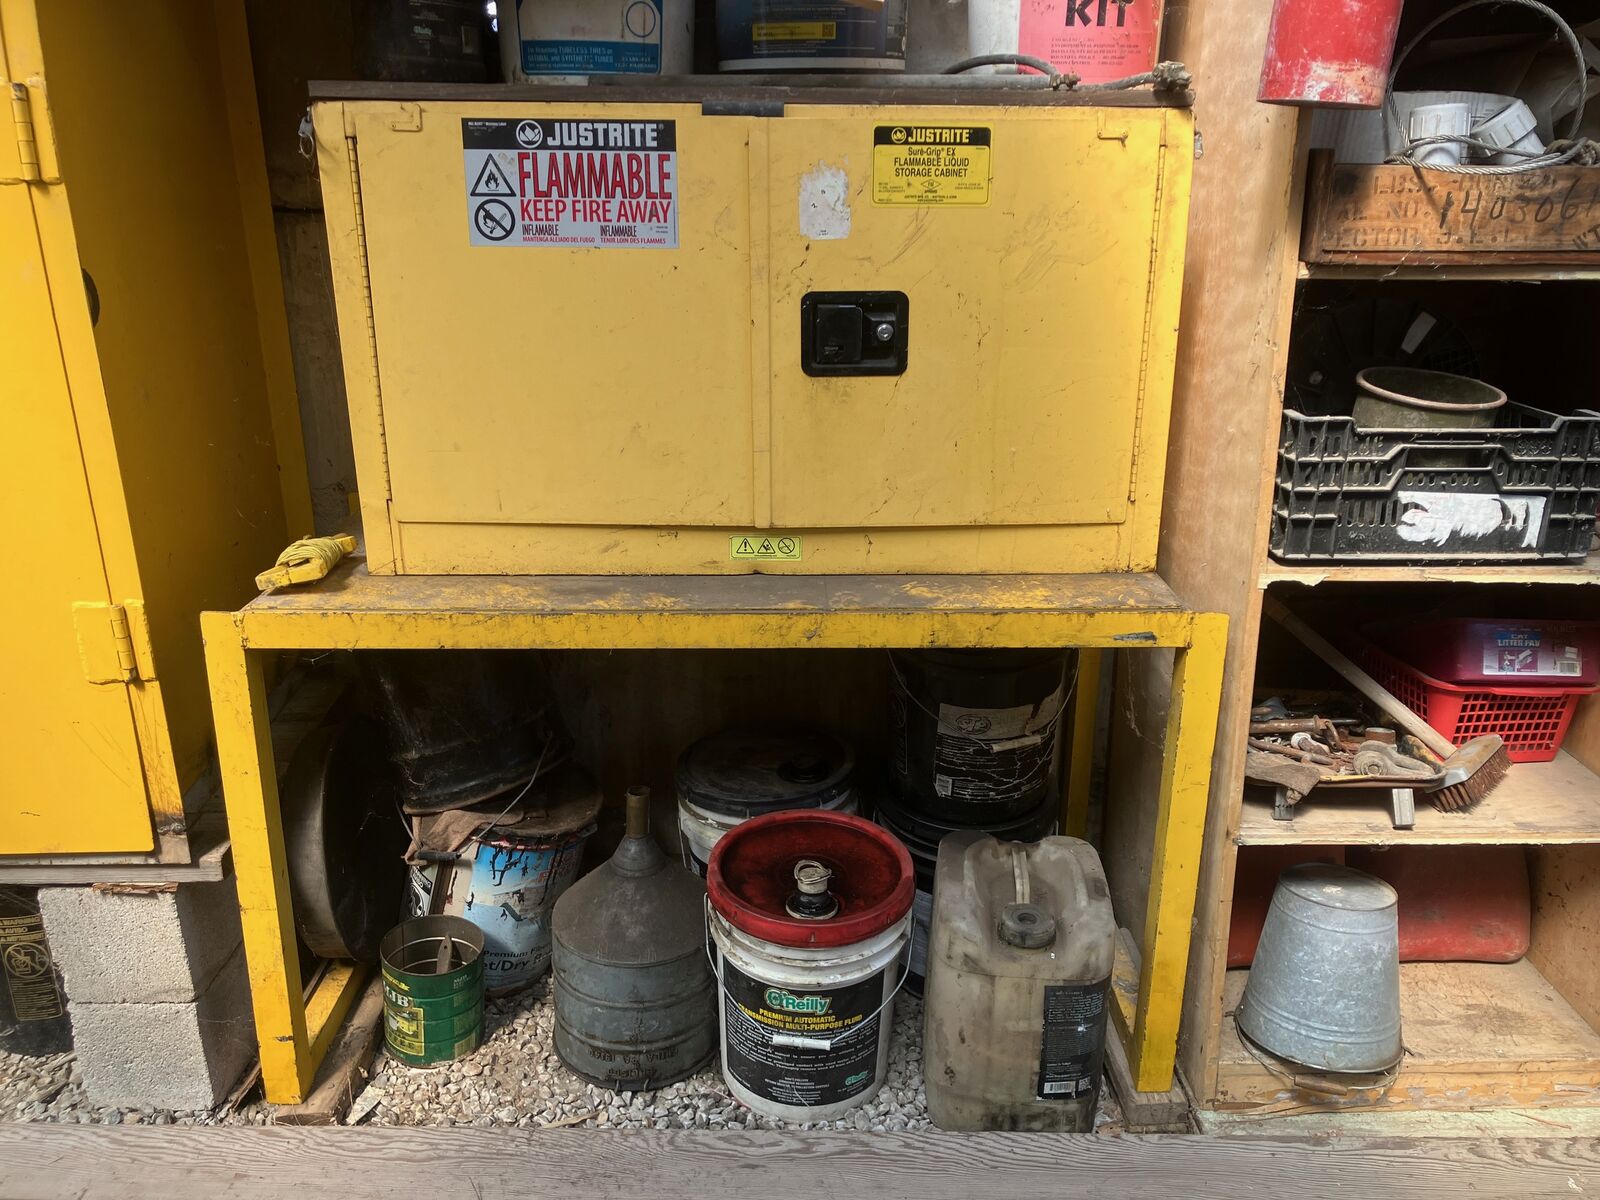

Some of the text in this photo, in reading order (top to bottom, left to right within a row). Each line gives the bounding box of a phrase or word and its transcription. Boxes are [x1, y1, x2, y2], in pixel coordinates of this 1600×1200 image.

[1065, 0, 1134, 27] KIT
[547, 122, 659, 148] JUSTRITE
[908, 128, 970, 143] JUSTRITE
[946, 147, 957, 157] EX
[894, 157, 970, 167] FLAMMABLE LIQUID
[517, 151, 672, 200] FLAMMABLE
[895, 168, 968, 178] STORAGE CABINET
[521, 199, 672, 223] KEEP FIRE AWAY
[522, 223, 560, 237] INFLAMABLE
[600, 224, 638, 238] INFLAMMABLE
[1498, 639, 1524, 647] LITTER
[484, 950, 528, 958] Premium
[483, 959, 531, 971] et/Dry
[766, 989, 831, 1014] O'Reilly
[760, 1008, 836, 1024] PREMIUM AUTOMATIC
[786, 1020, 843, 1030] MULTI-PURPOSE
[844, 1014, 863, 1026] FLUID
